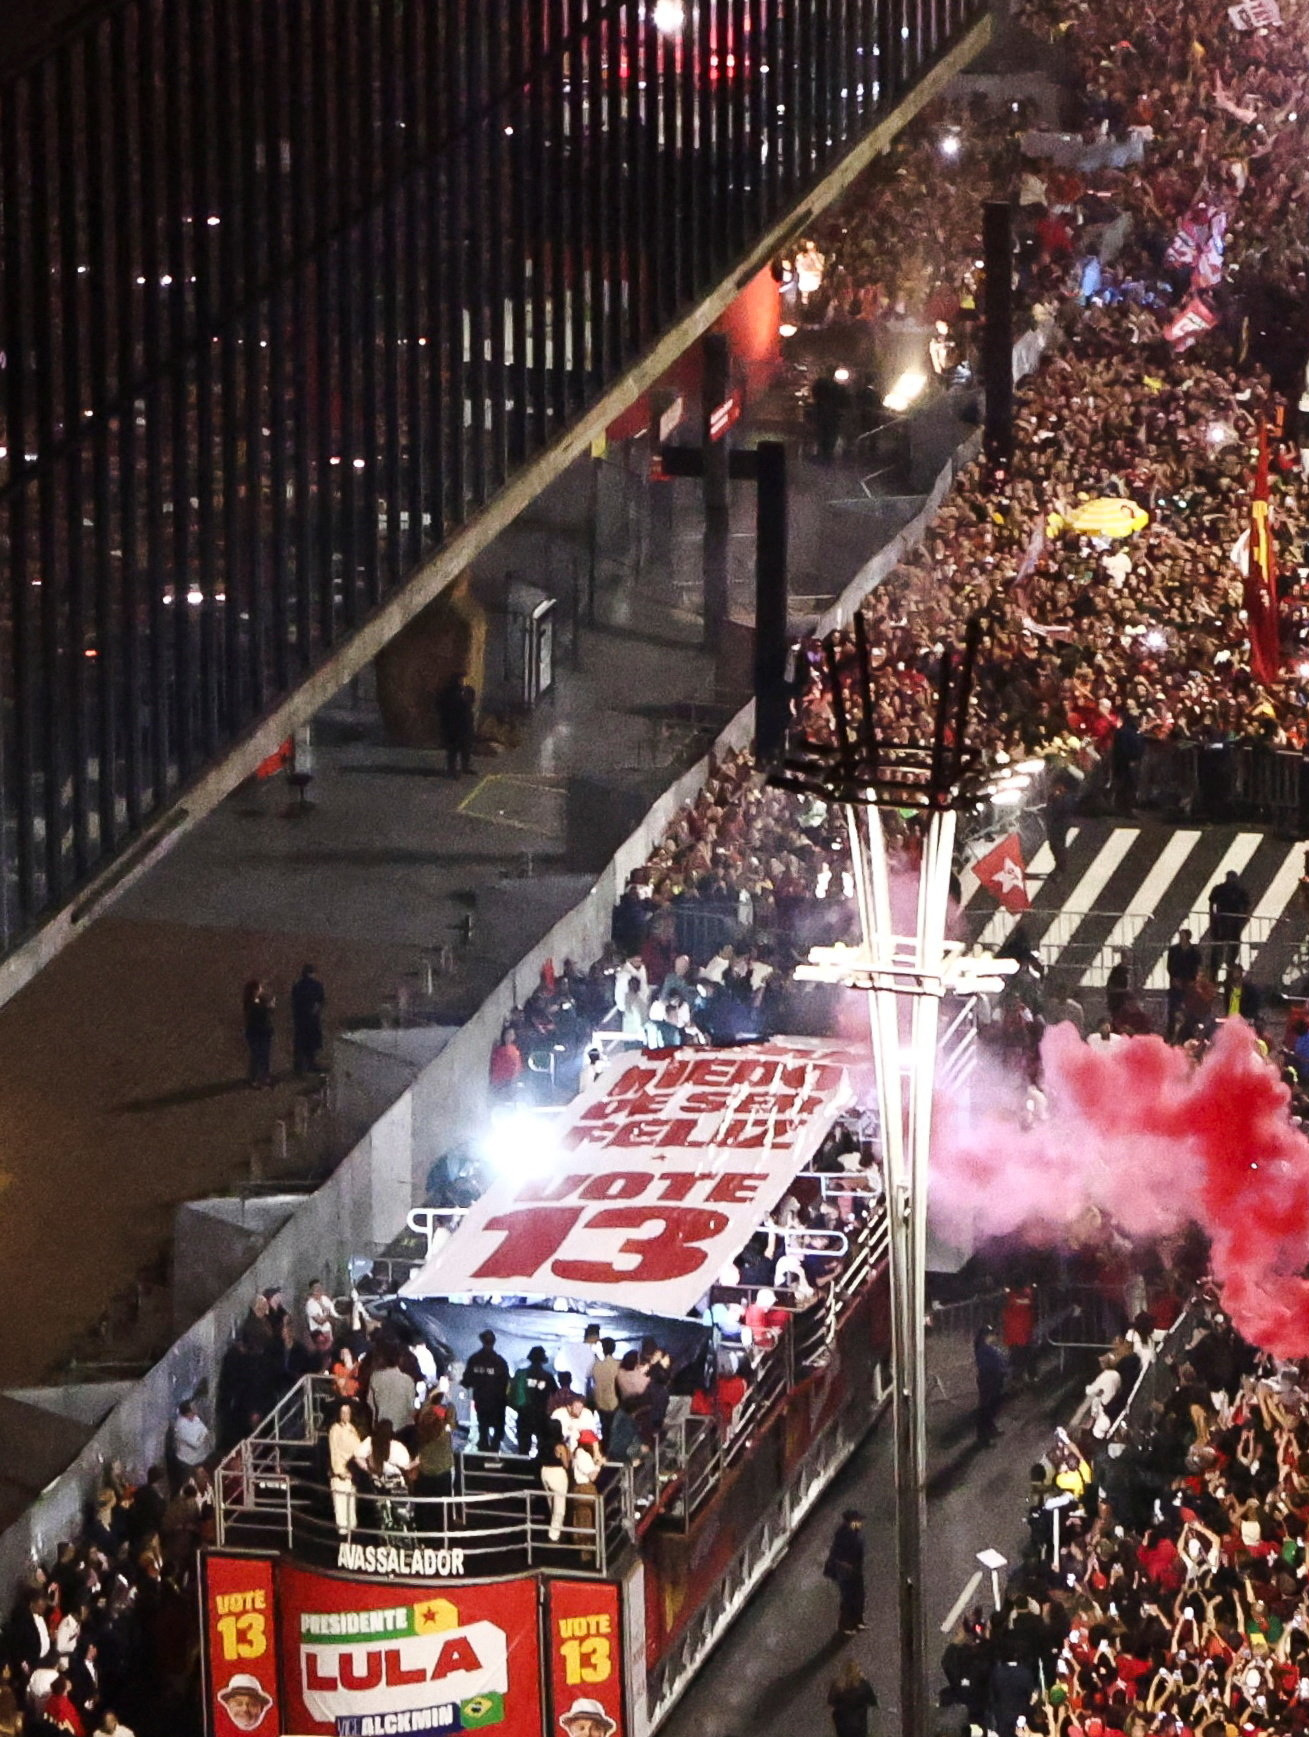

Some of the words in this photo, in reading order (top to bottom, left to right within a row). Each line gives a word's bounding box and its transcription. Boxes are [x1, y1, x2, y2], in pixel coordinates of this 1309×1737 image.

[514, 1171, 770, 1203] VOTE
[470, 1205, 730, 1283] 13
[337, 1542, 465, 1576] AVASSALADOR
[216, 1589, 266, 1615] VOTE
[217, 1612, 266, 1661] 13
[301, 1608, 408, 1634] PRESIDENTE
[559, 1613, 612, 1639] VOTE
[305, 1636, 483, 1692] LULA
[560, 1636, 612, 1686] 13
[361, 1703, 454, 1737] ALCKMIN
